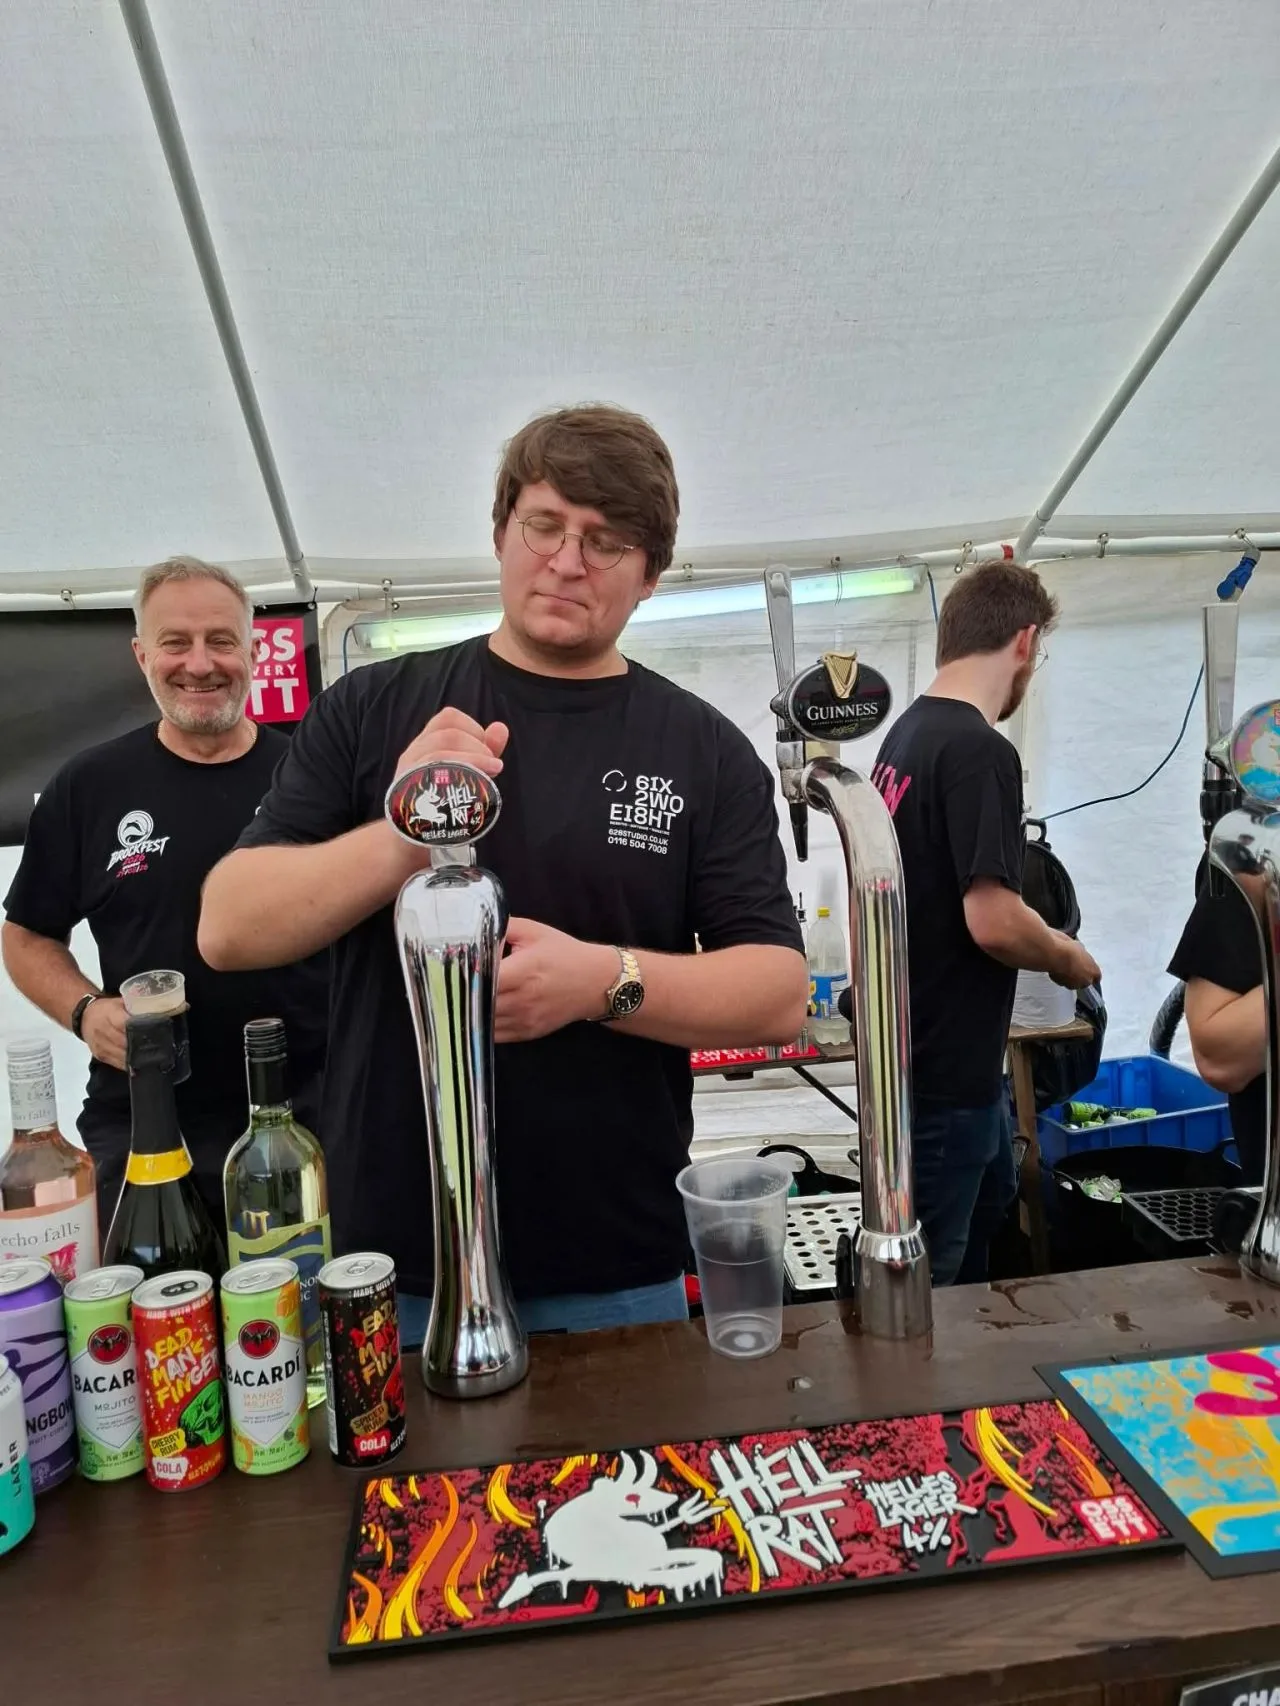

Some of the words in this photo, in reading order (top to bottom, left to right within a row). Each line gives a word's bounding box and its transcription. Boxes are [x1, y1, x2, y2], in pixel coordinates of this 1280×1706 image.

[251, 677, 299, 716] TT
[446, 784, 478, 809] HELL
[635, 775, 674, 795] 6IX
[634, 790, 684, 814] 2WO
[450, 805, 472, 827] RAT
[609, 803, 677, 831] EI8HT
[447, 828, 471, 839] LAGER
[607, 836, 628, 846] 0116
[629, 839, 646, 850] 504
[647, 843, 668, 855] 7008
[44, 1222, 81, 1244] falls
[353, 1287, 374, 1298] MADE
[151, 1429, 182, 1449] CHERRY
[160, 1443, 179, 1457] RUM
[359, 1435, 387, 1452] COLA
[9, 1440, 22, 1497] LAGER
[156, 1461, 183, 1474] COLA
[710, 1437, 864, 1523] HELL
[864, 1470, 960, 1510] HELLES
[877, 1494, 979, 1528] LAGER
[744, 1498, 845, 1578] RAT
[902, 1517, 952, 1554] 4%
